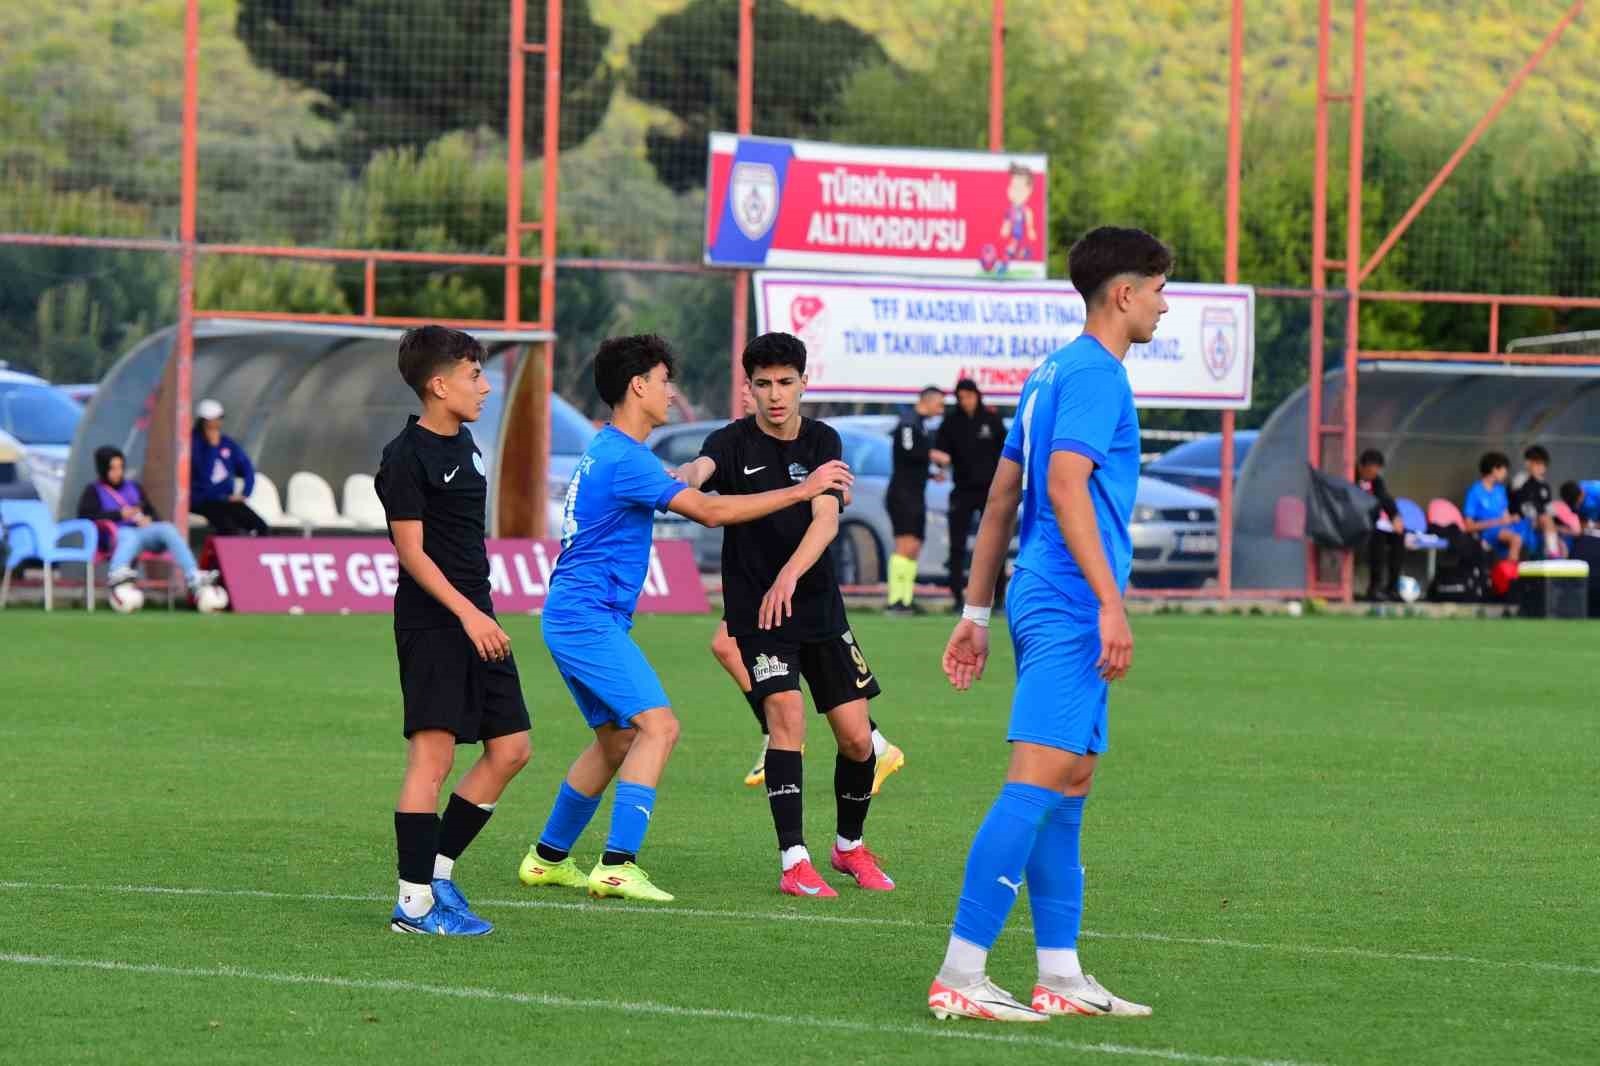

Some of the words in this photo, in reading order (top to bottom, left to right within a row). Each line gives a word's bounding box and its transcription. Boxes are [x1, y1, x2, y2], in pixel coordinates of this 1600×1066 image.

[819, 167, 956, 210] TÜRKİYE'NİN
[807, 213, 966, 251] ALTINORDU'SU
[870, 297, 899, 321] TFF
[259, 552, 340, 597] TFF
[850, 644, 868, 675] 9
